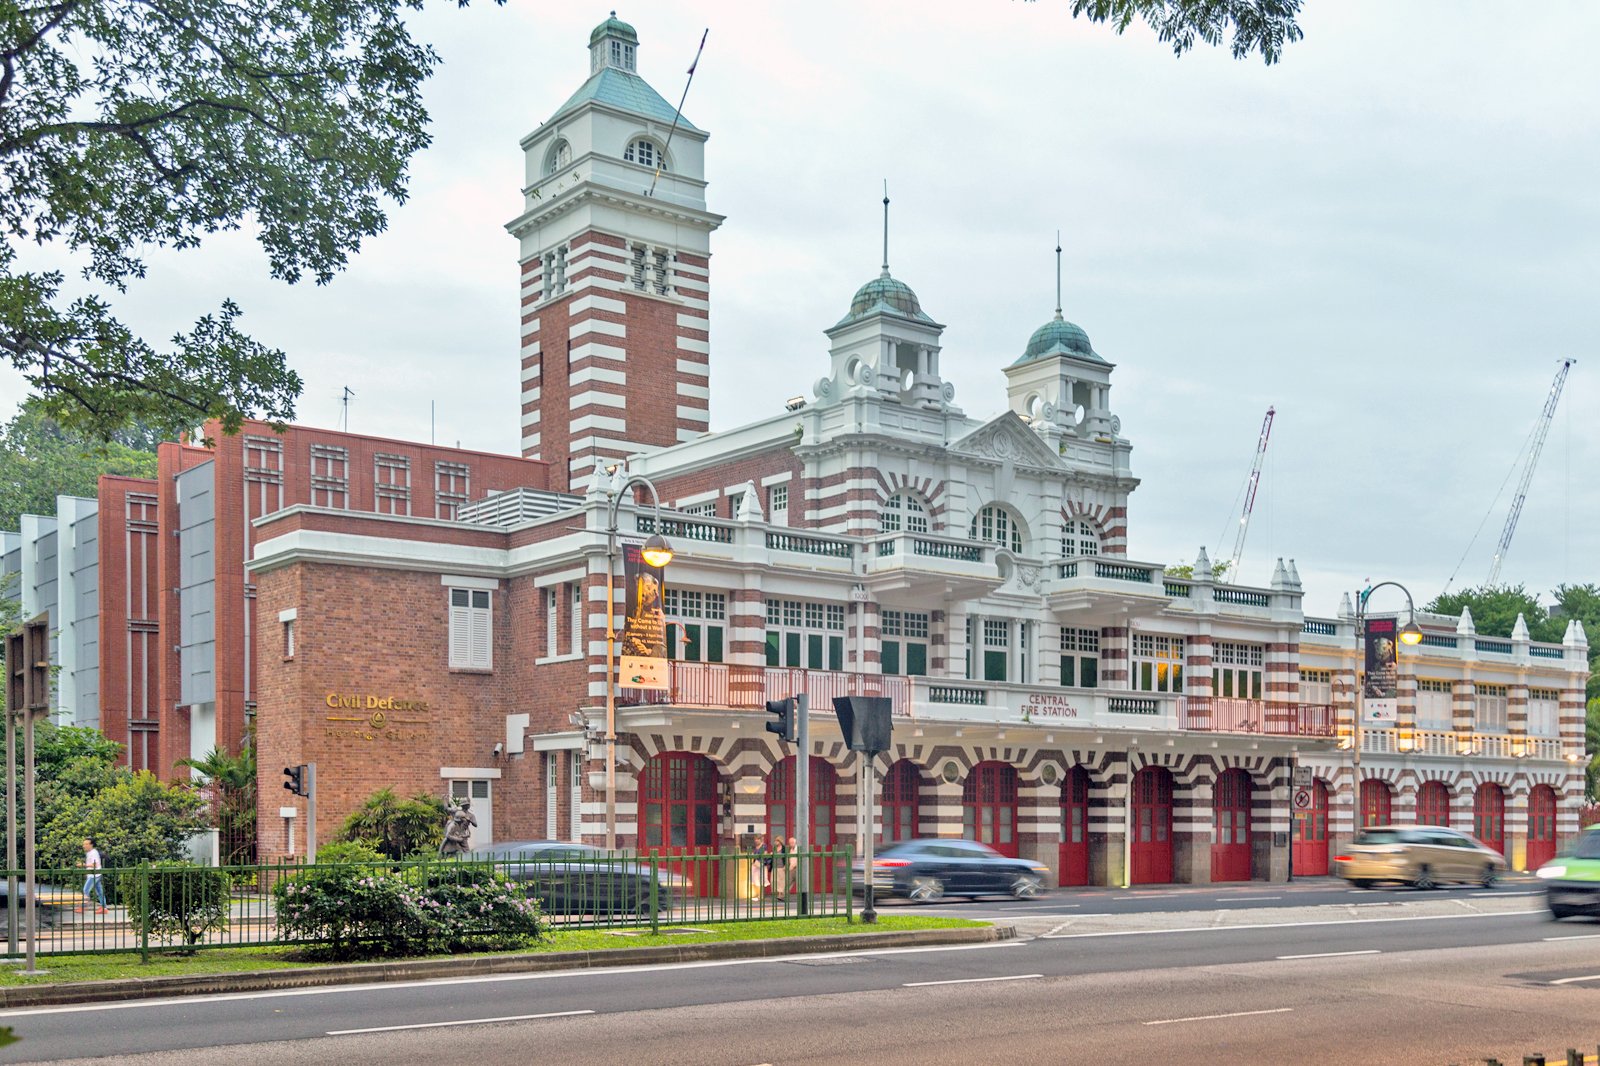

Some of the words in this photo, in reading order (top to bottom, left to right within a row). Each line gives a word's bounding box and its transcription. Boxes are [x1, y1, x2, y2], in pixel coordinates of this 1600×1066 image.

[627, 616, 637, 624] They
[326, 693, 360, 708] Civil
[366, 695, 429, 712] Defence
[1029, 694, 1069, 706] CENTRAL
[1020, 705, 1038, 716] FIRE
[1042, 706, 1077, 718] STATION
